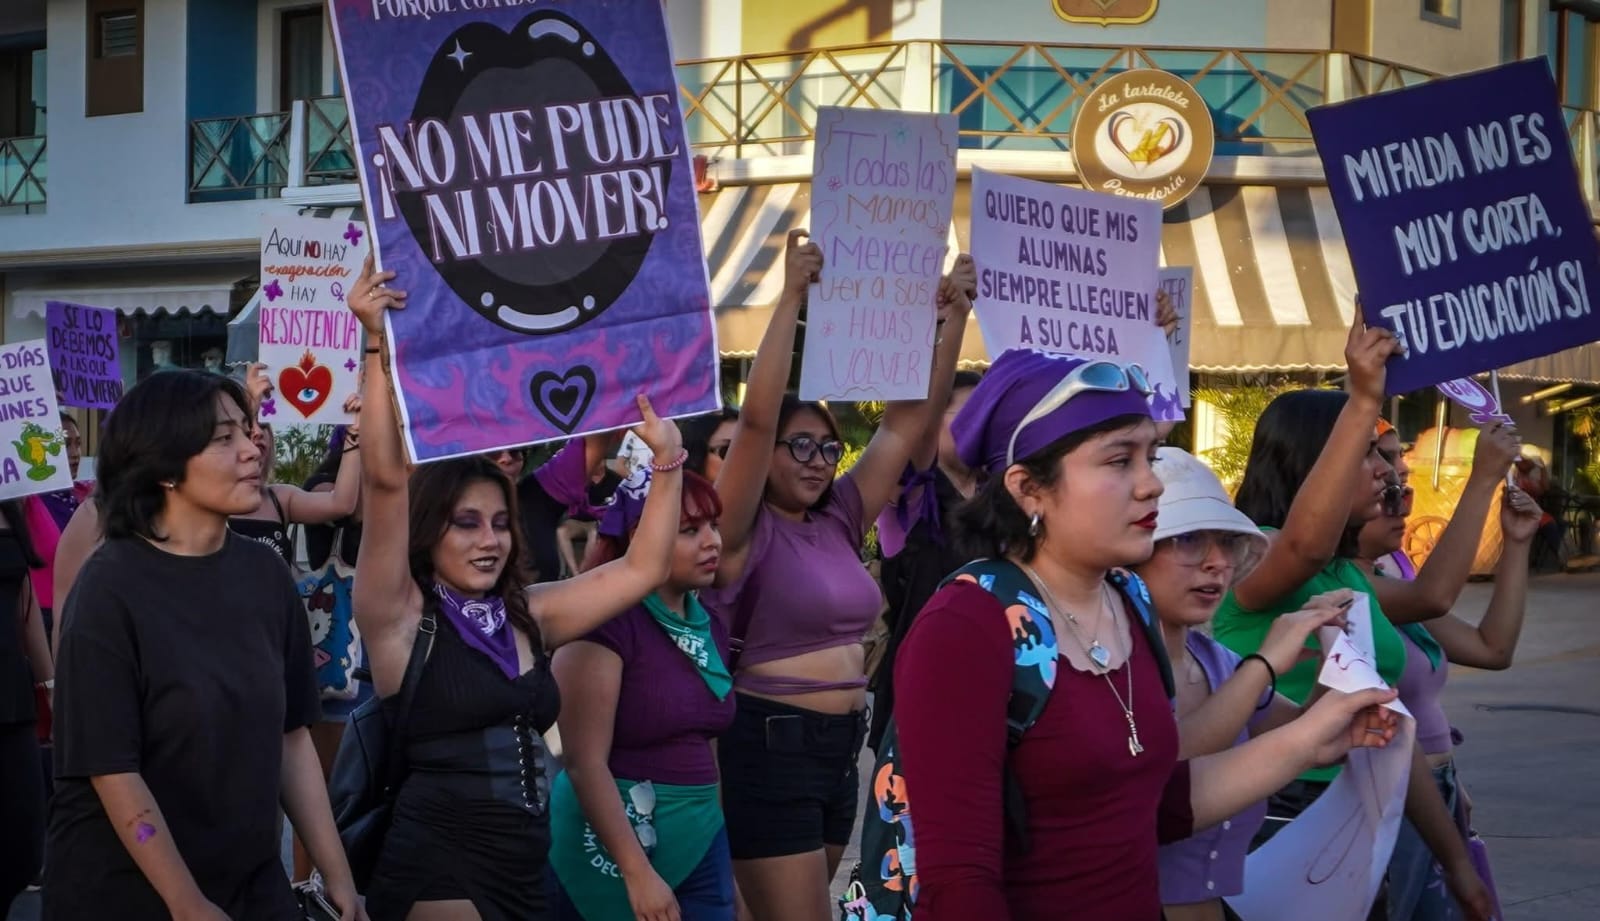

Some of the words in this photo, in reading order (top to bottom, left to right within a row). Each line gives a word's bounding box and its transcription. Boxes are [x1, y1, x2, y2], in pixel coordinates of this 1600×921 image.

[1098, 92, 1119, 112] La
[1124, 83, 1190, 108] tartaleta
[463, 109, 543, 180] ME
[545, 94, 679, 170] PUDE
[832, 130, 911, 188] Todas
[914, 136, 948, 195] las
[1344, 148, 1389, 201] MI
[1387, 132, 1464, 193] FALDA
[1467, 121, 1509, 174] NO
[1510, 112, 1552, 165] ES
[426, 189, 482, 260] NI
[487, 167, 668, 251] MOVER!
[985, 189, 1054, 229] QUIERO
[1061, 204, 1100, 237] QUE
[1106, 211, 1138, 242] MIS
[304, 241, 321, 258] NO
[324, 243, 347, 261] HAY
[1394, 211, 1458, 275] MUY
[1463, 193, 1562, 254] CORTA,
[264, 263, 351, 282] exageración
[1018, 236, 1107, 276] ALUMNAS
[291, 285, 317, 303] HAY
[871, 276, 885, 299] a
[982, 268, 1063, 309] SIEMPRE
[1068, 284, 1149, 321] LLEGUEN
[63, 305, 79, 328] SE
[85, 309, 102, 332] LO
[1381, 300, 1428, 359] TU
[1429, 256, 1560, 351] EDUCACIÓN
[1559, 260, 1591, 318] SI
[52, 326, 114, 361] DEBEMOS
[261, 307, 358, 350] RESISTENCIA
[850, 307, 913, 345] HIJAS
[1020, 315, 1033, 344] A
[1038, 318, 1062, 347] SU
[1068, 322, 1119, 355] CASA
[2, 345, 44, 369] DÍAS
[60, 354, 67, 369] A
[70, 356, 87, 373] LAS
[89, 360, 109, 376] QUE
[829, 347, 921, 390] VOLVER
[53, 368, 69, 393] NO
[0, 397, 48, 421] INES
[0, 457, 20, 484] A
[589, 854, 623, 878] DEC
